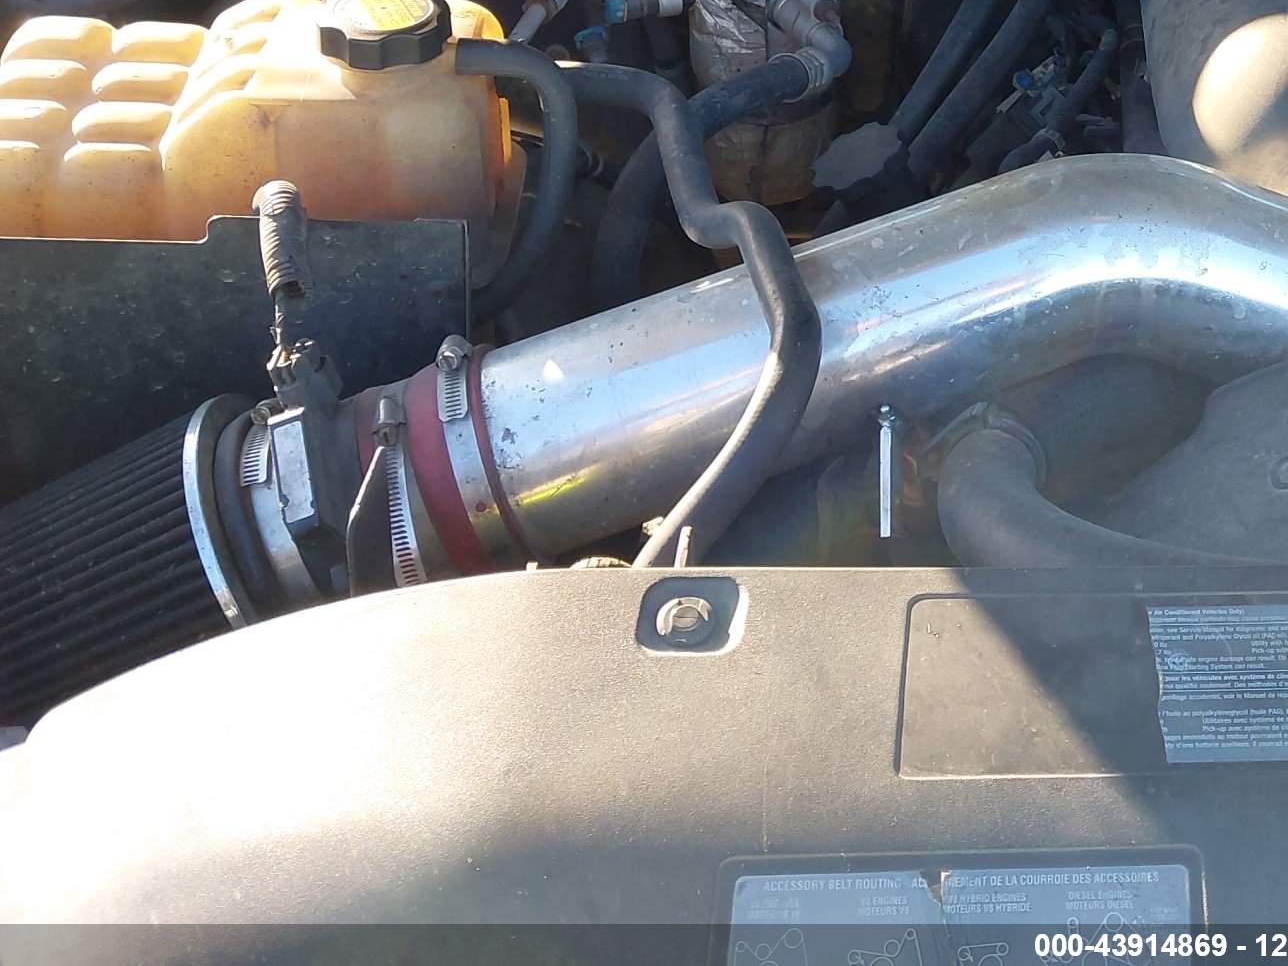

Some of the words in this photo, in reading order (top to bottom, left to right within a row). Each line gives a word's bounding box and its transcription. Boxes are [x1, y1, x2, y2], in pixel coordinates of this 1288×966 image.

[764, 879, 825, 892] ACCESSORY
[828, 879, 852, 891] BELT
[855, 877, 902, 890] ROUTING
[990, 875, 1003, 887] DE
[1005, 875, 1018, 887] LA
[1020, 873, 1070, 886] COURROIE
[1072, 873, 1091, 884] DES
[1094, 871, 1160, 884] ACCESSOIRES
